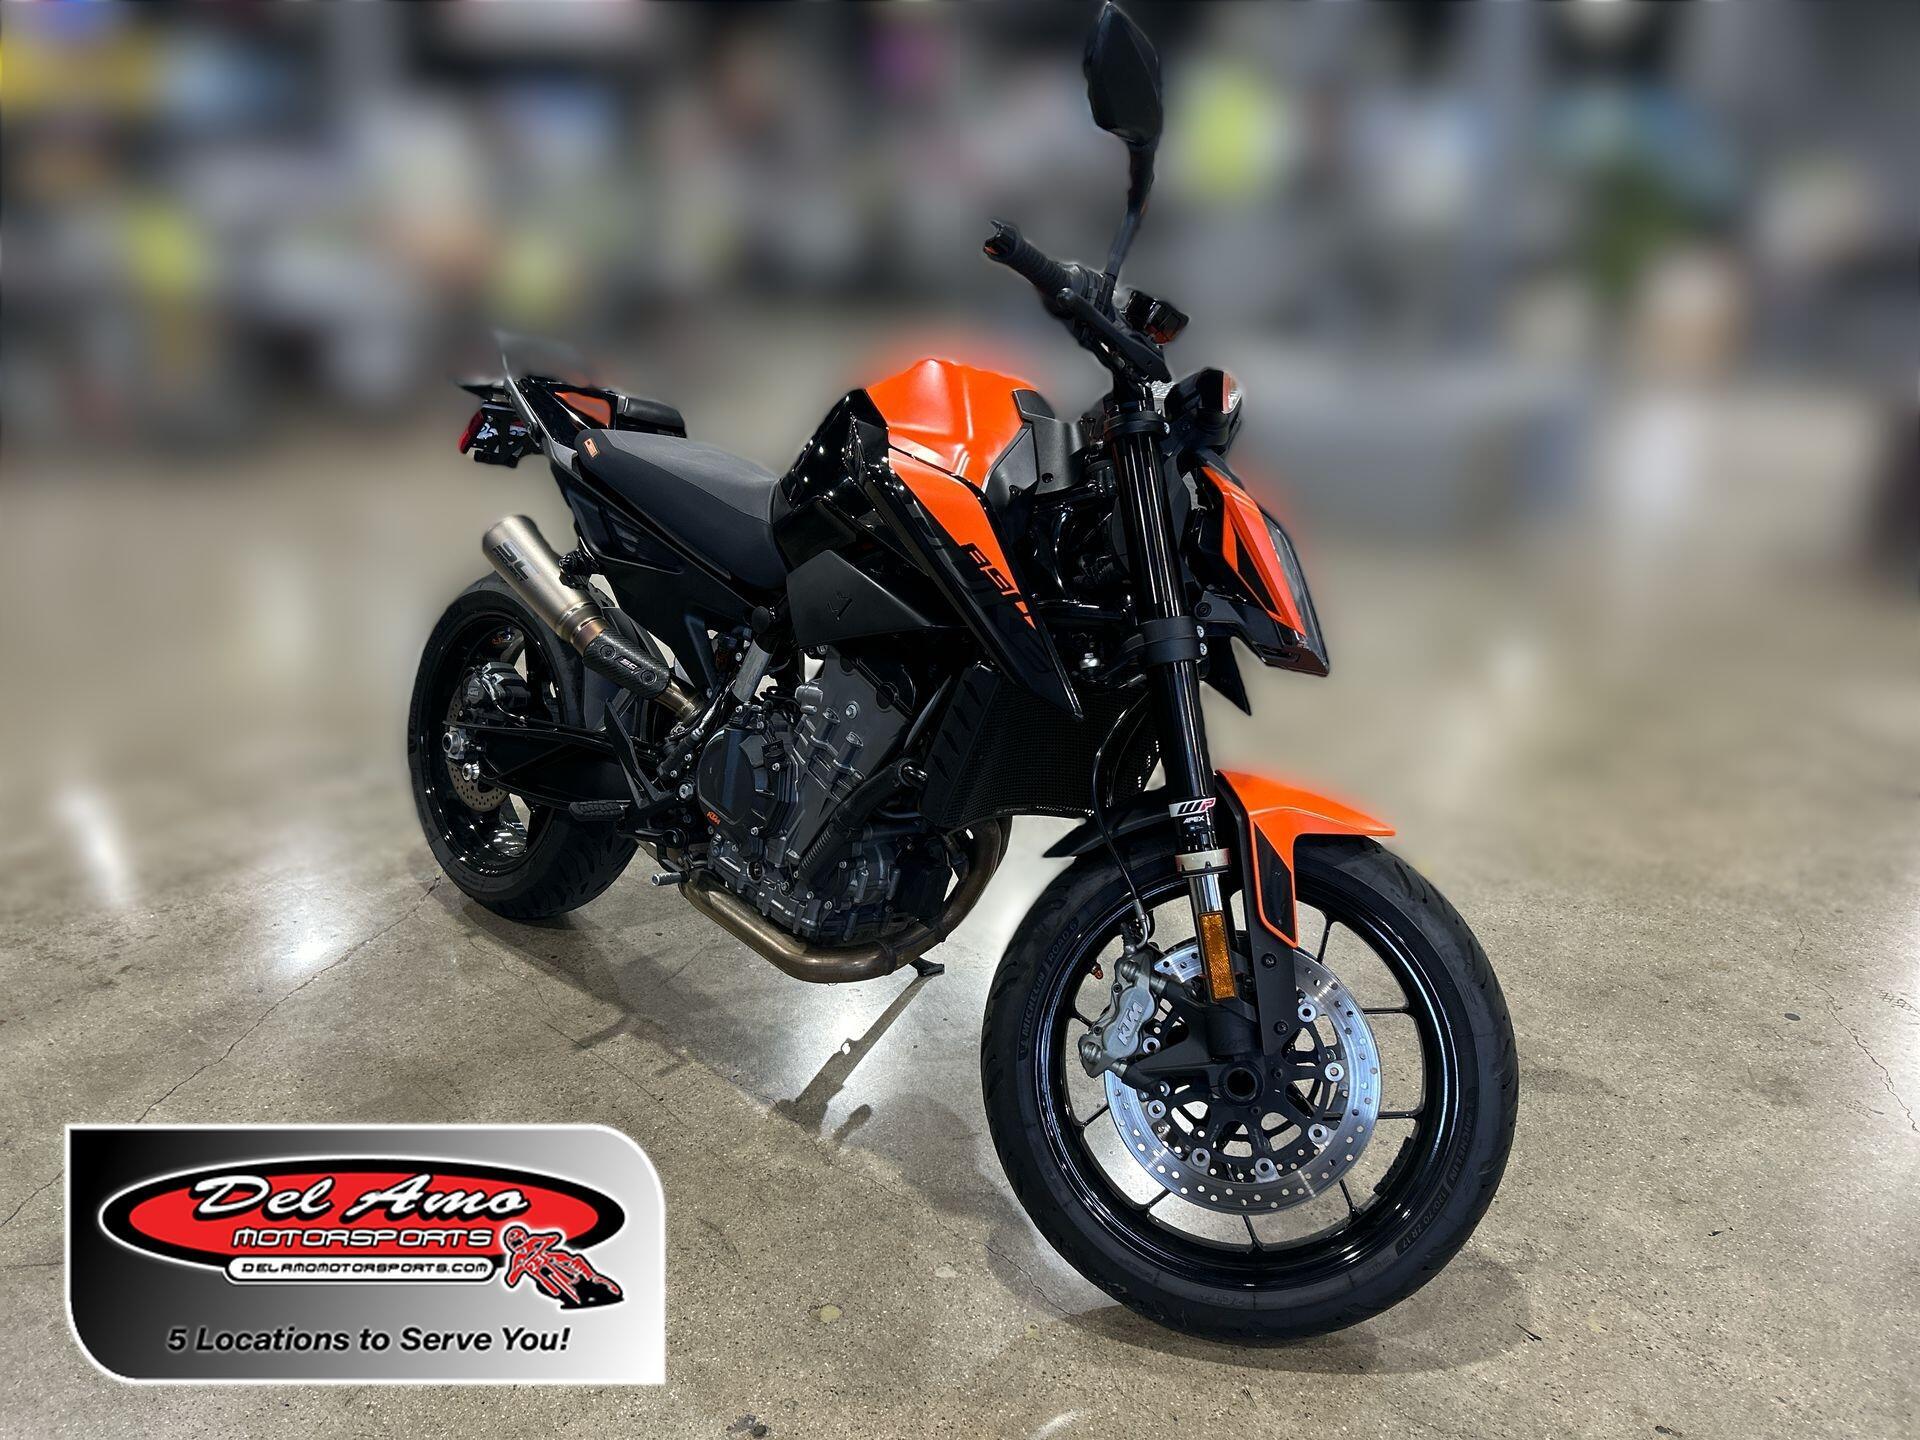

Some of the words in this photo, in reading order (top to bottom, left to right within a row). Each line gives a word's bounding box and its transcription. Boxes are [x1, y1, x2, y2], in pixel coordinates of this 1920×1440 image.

[706, 811, 721, 825] KTM
[1177, 798, 1215, 815] WP
[1183, 815, 1206, 824] APEX
[1021, 974, 1047, 1038] MICHELIN
[1048, 932, 1071, 963] ROAD
[1116, 1001, 1143, 1046] KTM
[1449, 1110, 1476, 1181] MICHELIN
